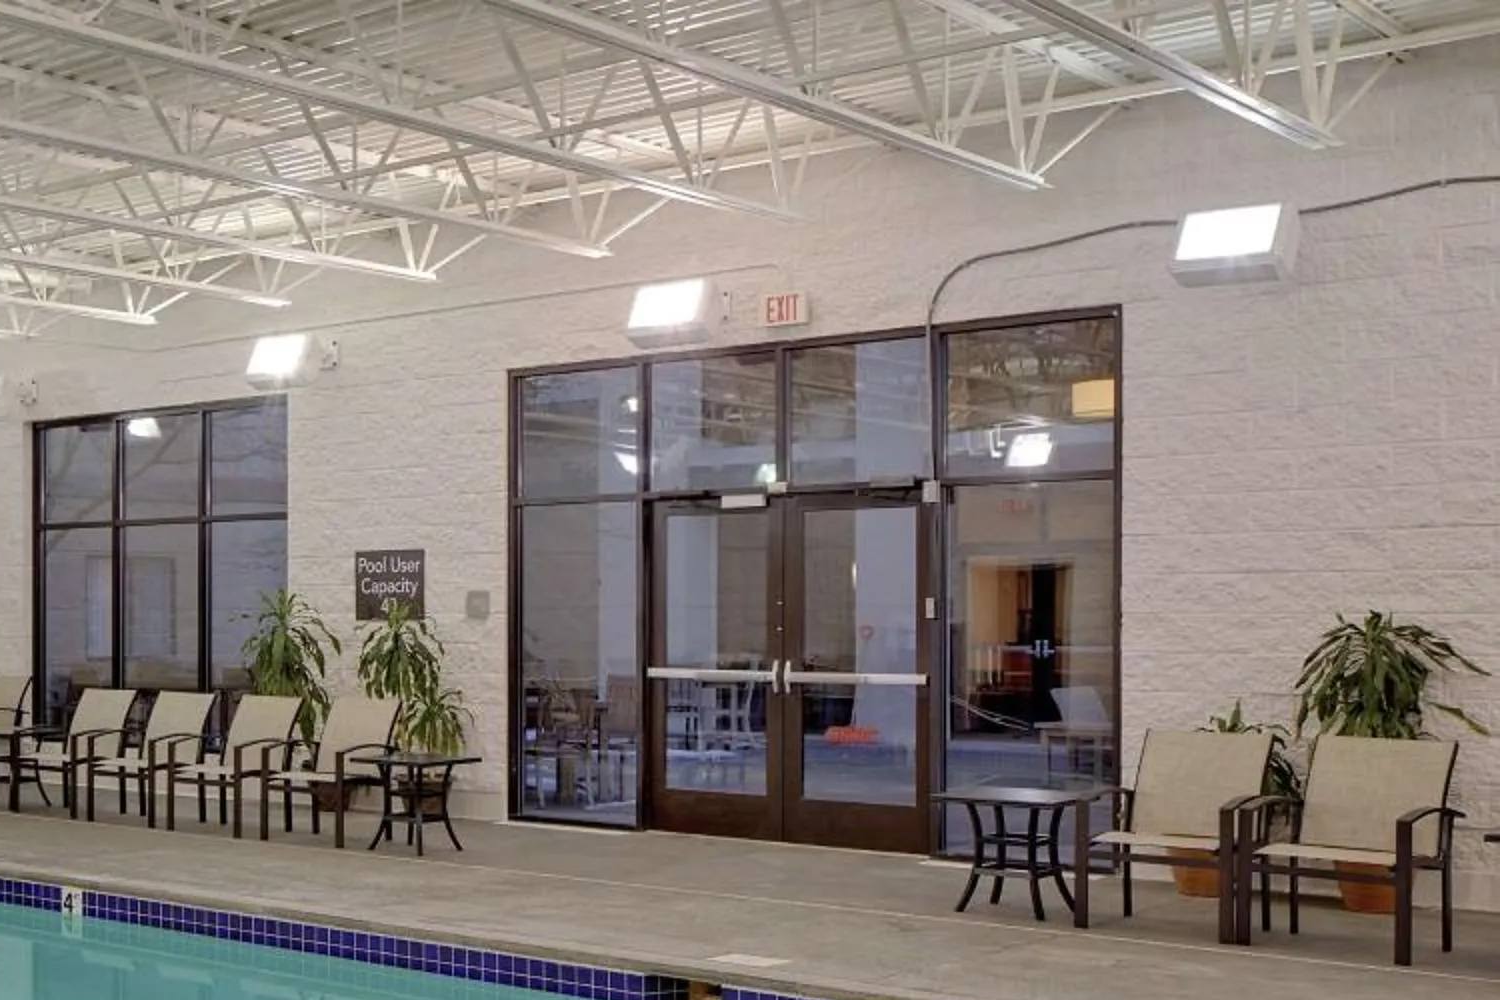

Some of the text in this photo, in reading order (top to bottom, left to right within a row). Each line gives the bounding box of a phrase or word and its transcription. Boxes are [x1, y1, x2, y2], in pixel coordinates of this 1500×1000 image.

[766, 295, 799, 322] EXIT
[358, 556, 420, 573] Pool User
[361, 577, 418, 598] Capacity
[63, 893, 73, 913] 4
